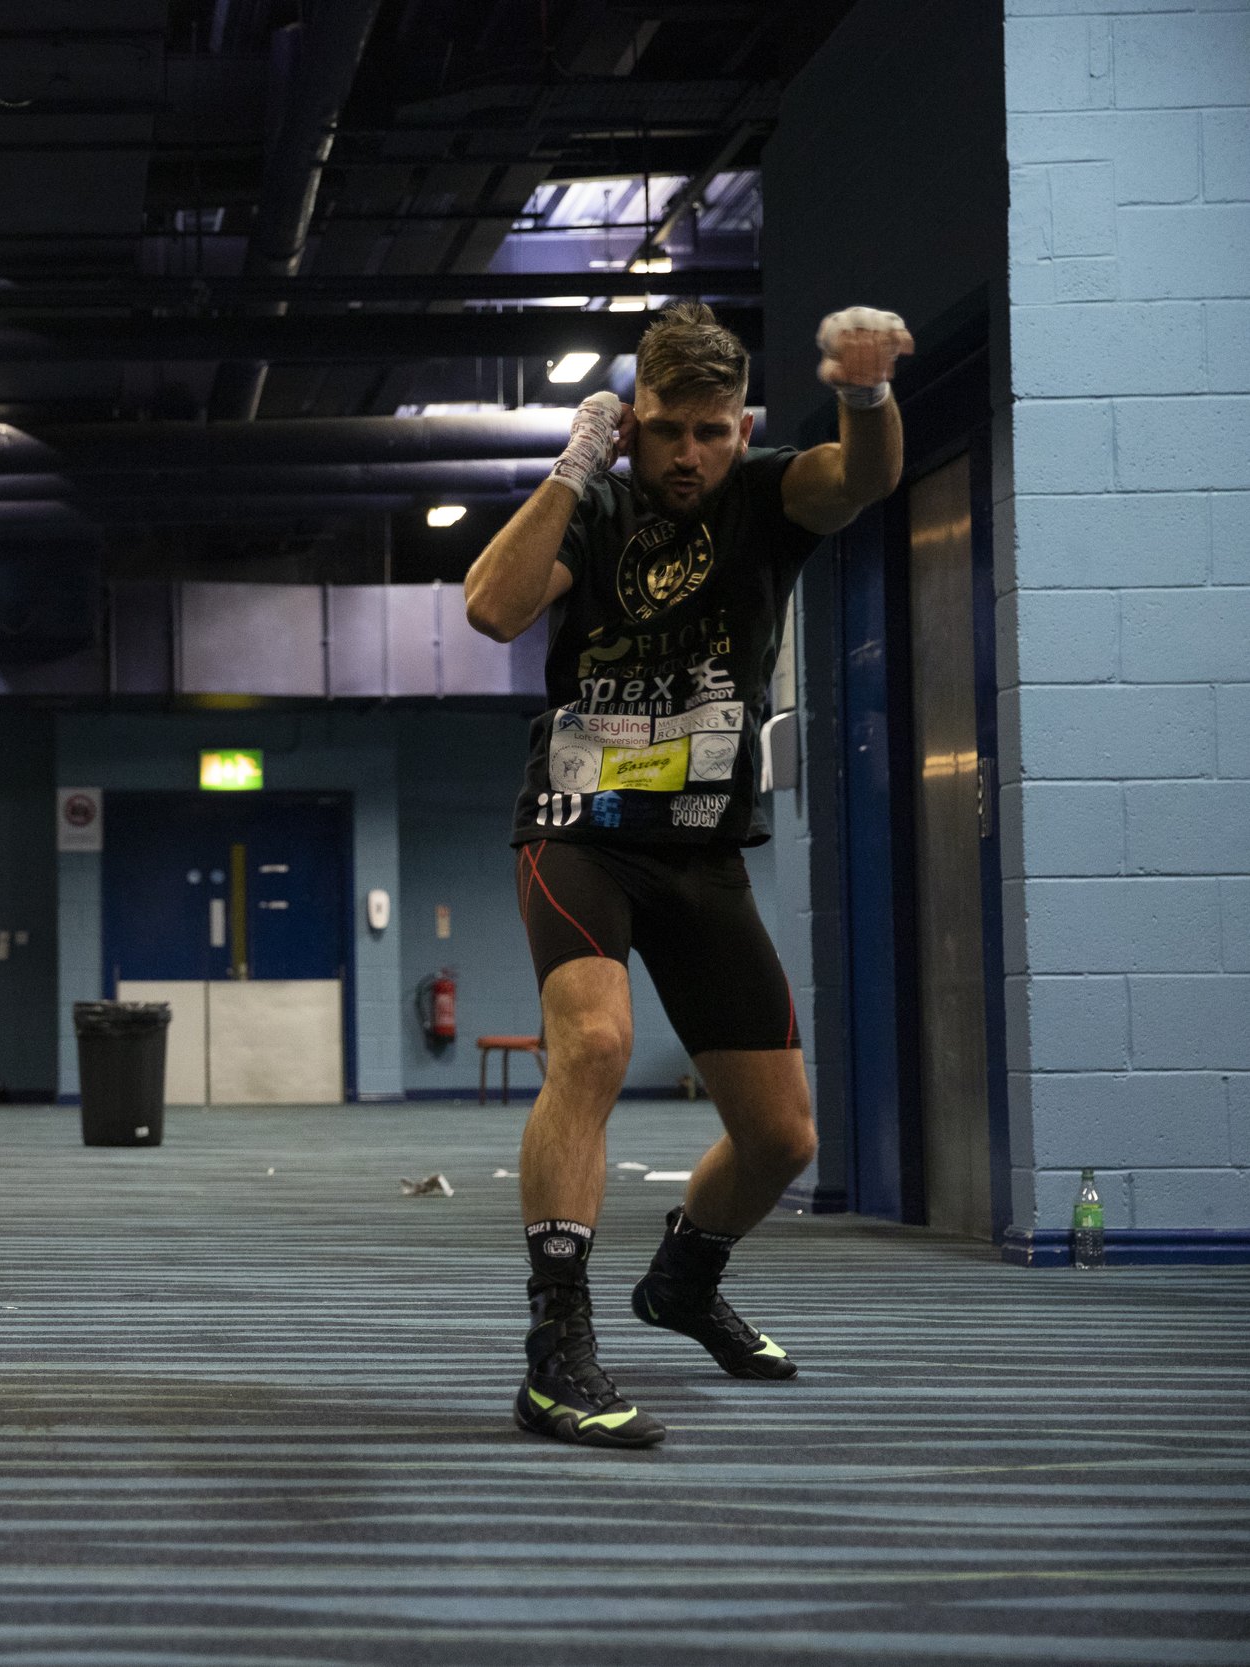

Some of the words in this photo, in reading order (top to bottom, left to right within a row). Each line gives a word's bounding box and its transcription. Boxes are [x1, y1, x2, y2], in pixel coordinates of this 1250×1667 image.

[588, 718, 650, 736] Skyline
[656, 716, 719, 740] BOXNG
[574, 732, 592, 742] Loft
[593, 735, 650, 745] Conversions
[527, 1221, 551, 1237] SUZI
